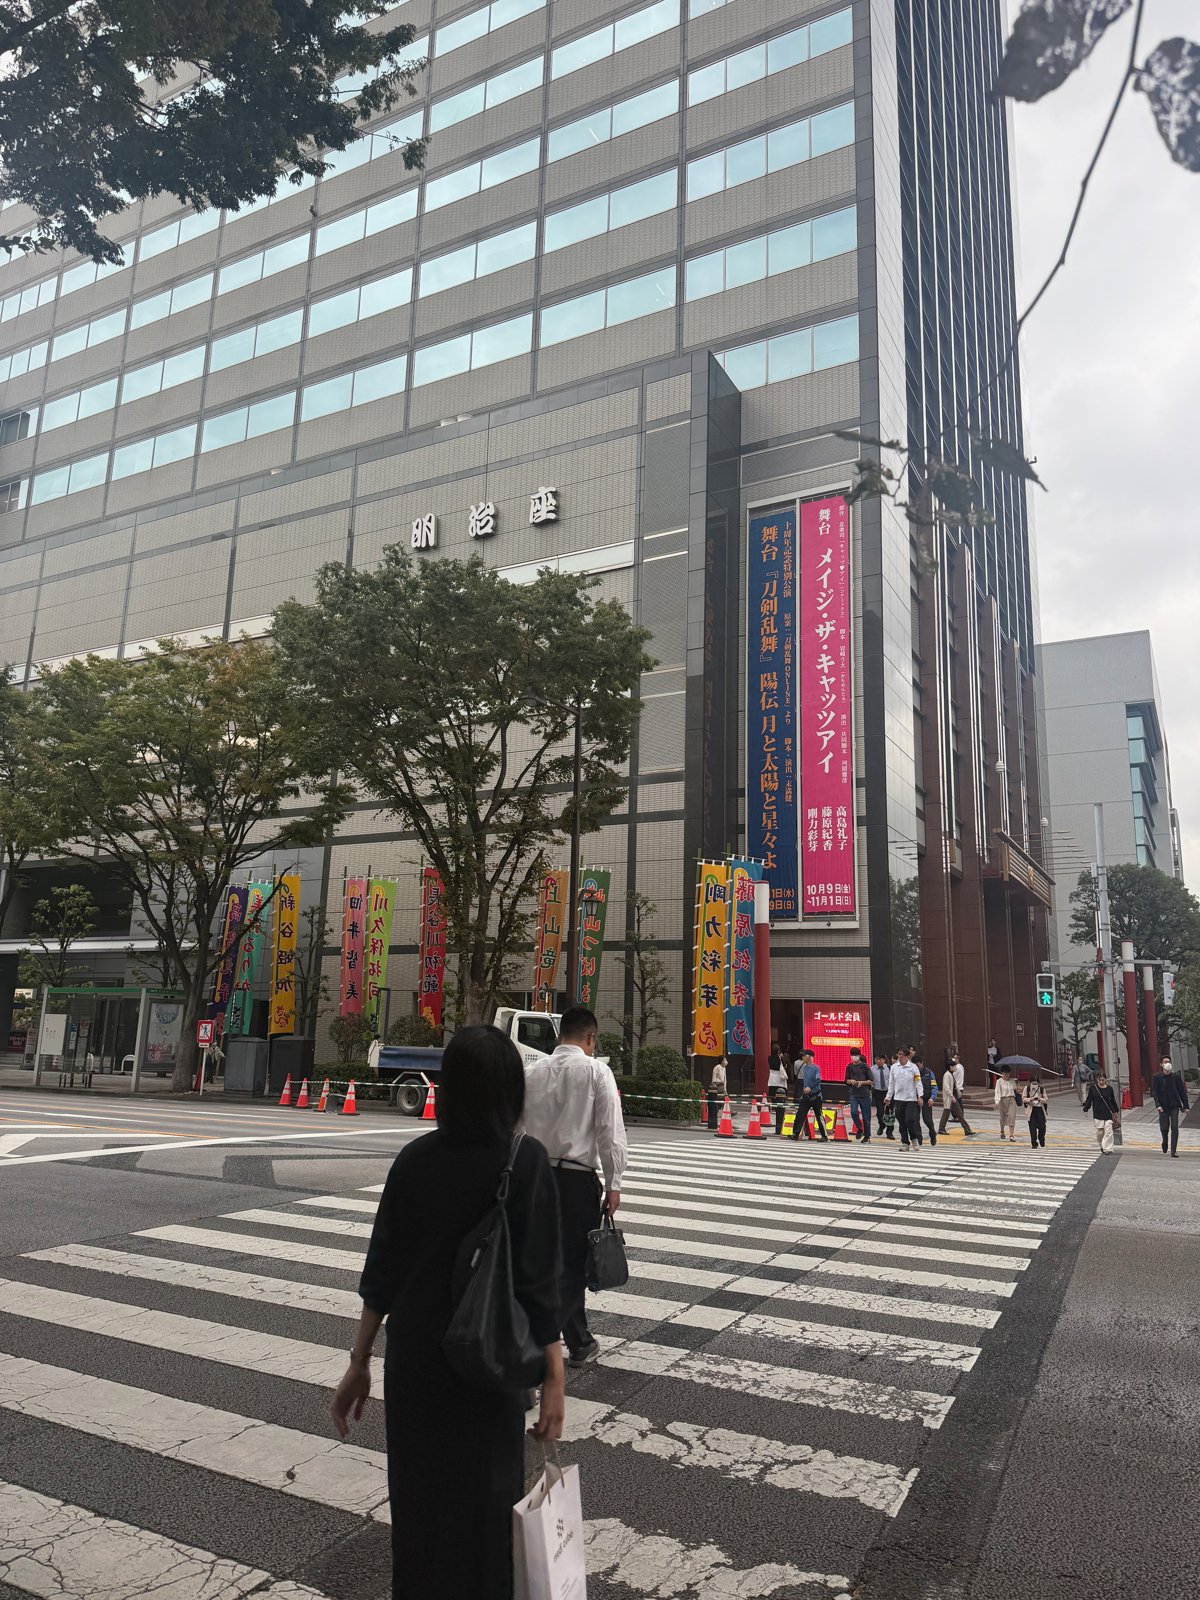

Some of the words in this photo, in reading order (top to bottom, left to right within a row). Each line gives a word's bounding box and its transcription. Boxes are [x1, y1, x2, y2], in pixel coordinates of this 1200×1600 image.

[411, 486, 558, 549] 明治座
[818, 508, 831, 536] 舞台
[815, 547, 837, 774] メイジ・ザ・キャッツアイ
[807, 807, 818, 852] 剛力彩芽
[821, 806, 833, 851] 藤原紀香
[836, 805, 848, 851] 高島礼子
[813, 1011, 861, 1022] ゴールド会員
